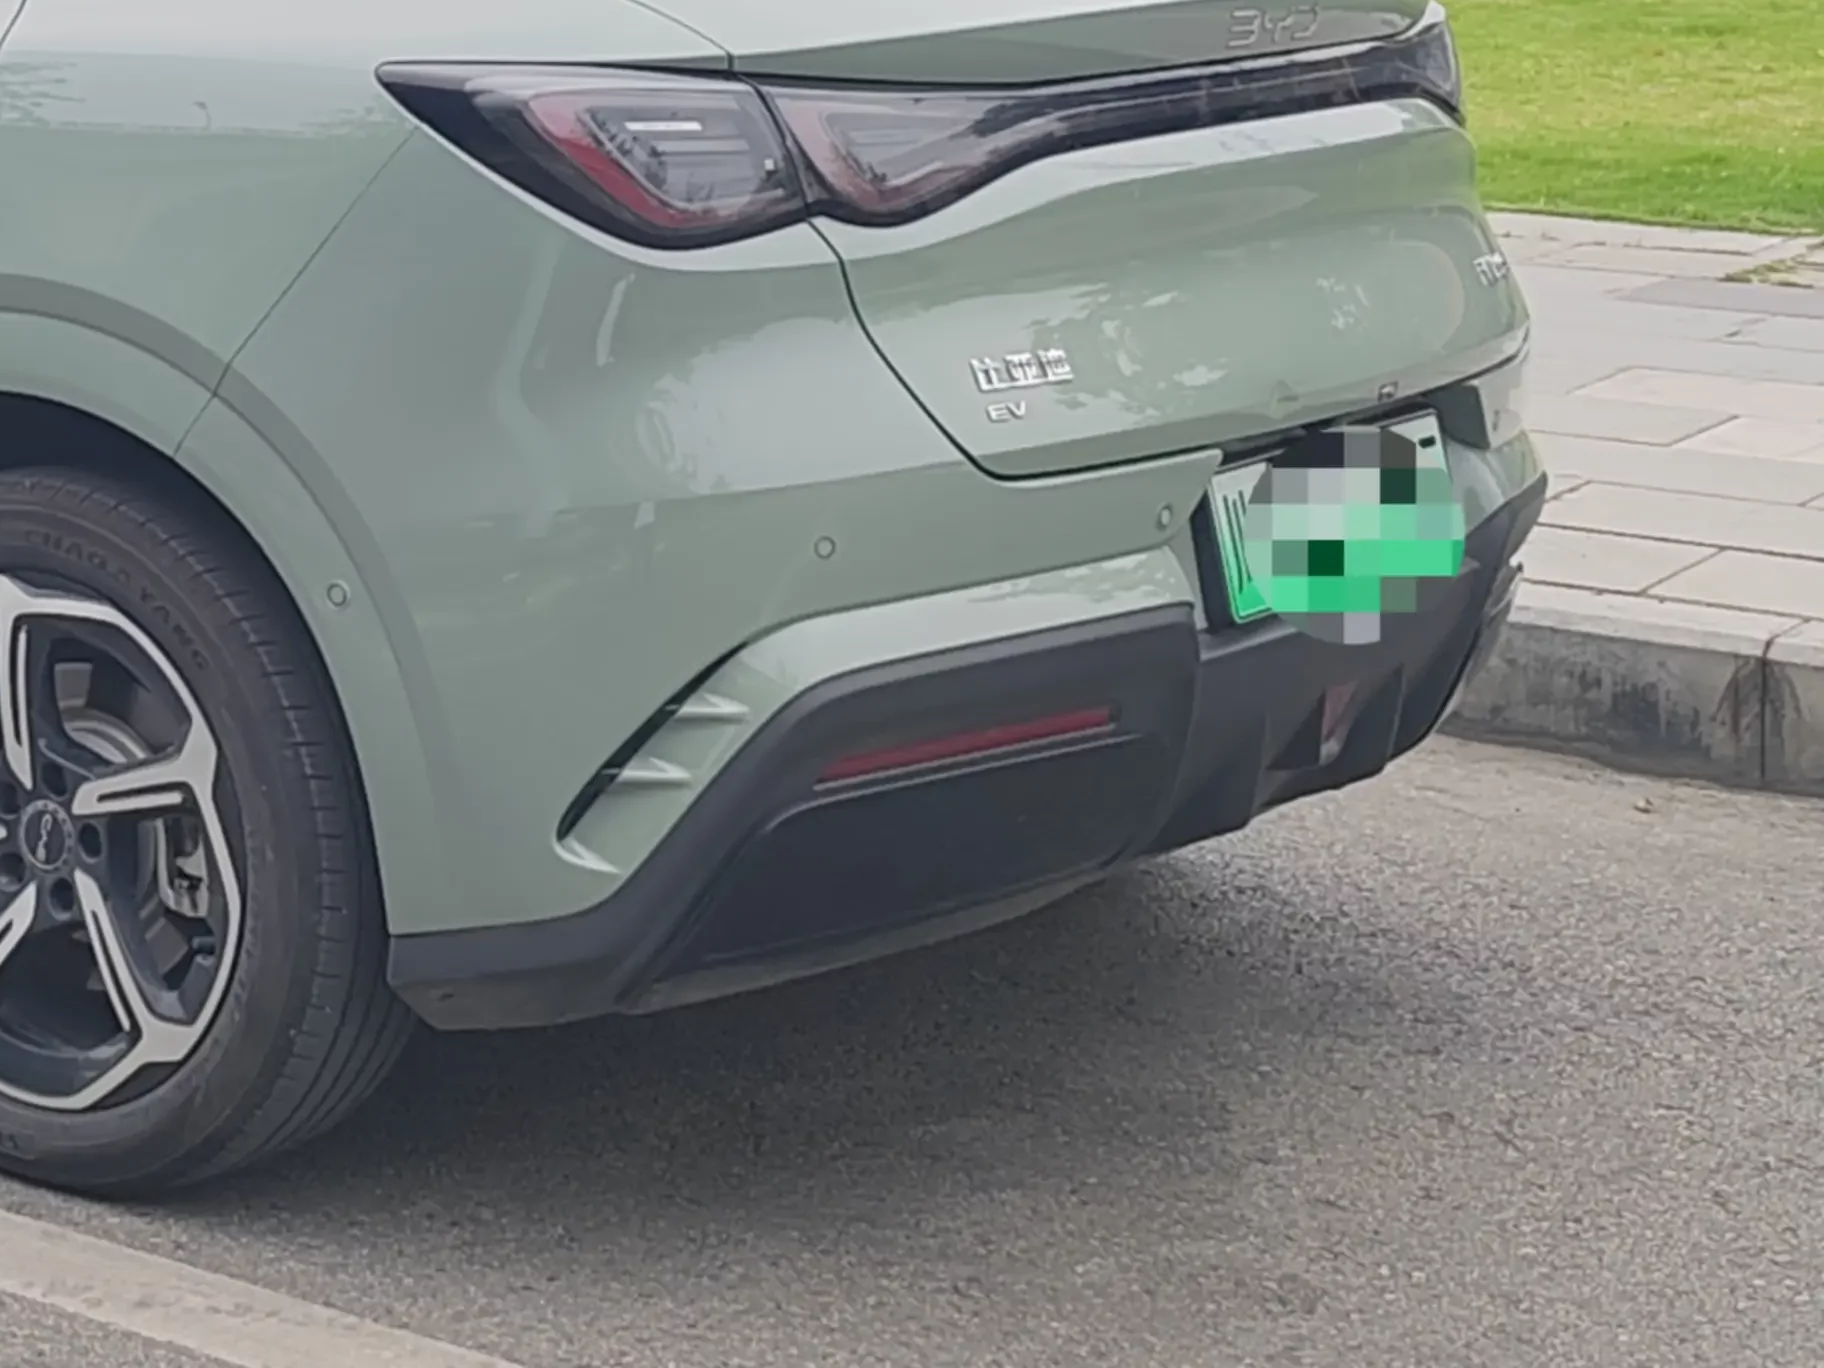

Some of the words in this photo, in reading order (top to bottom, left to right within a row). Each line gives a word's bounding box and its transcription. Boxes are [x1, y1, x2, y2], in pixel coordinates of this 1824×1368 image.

[969, 348, 1074, 392] 比亚迪
[986, 400, 1027, 422] EV
